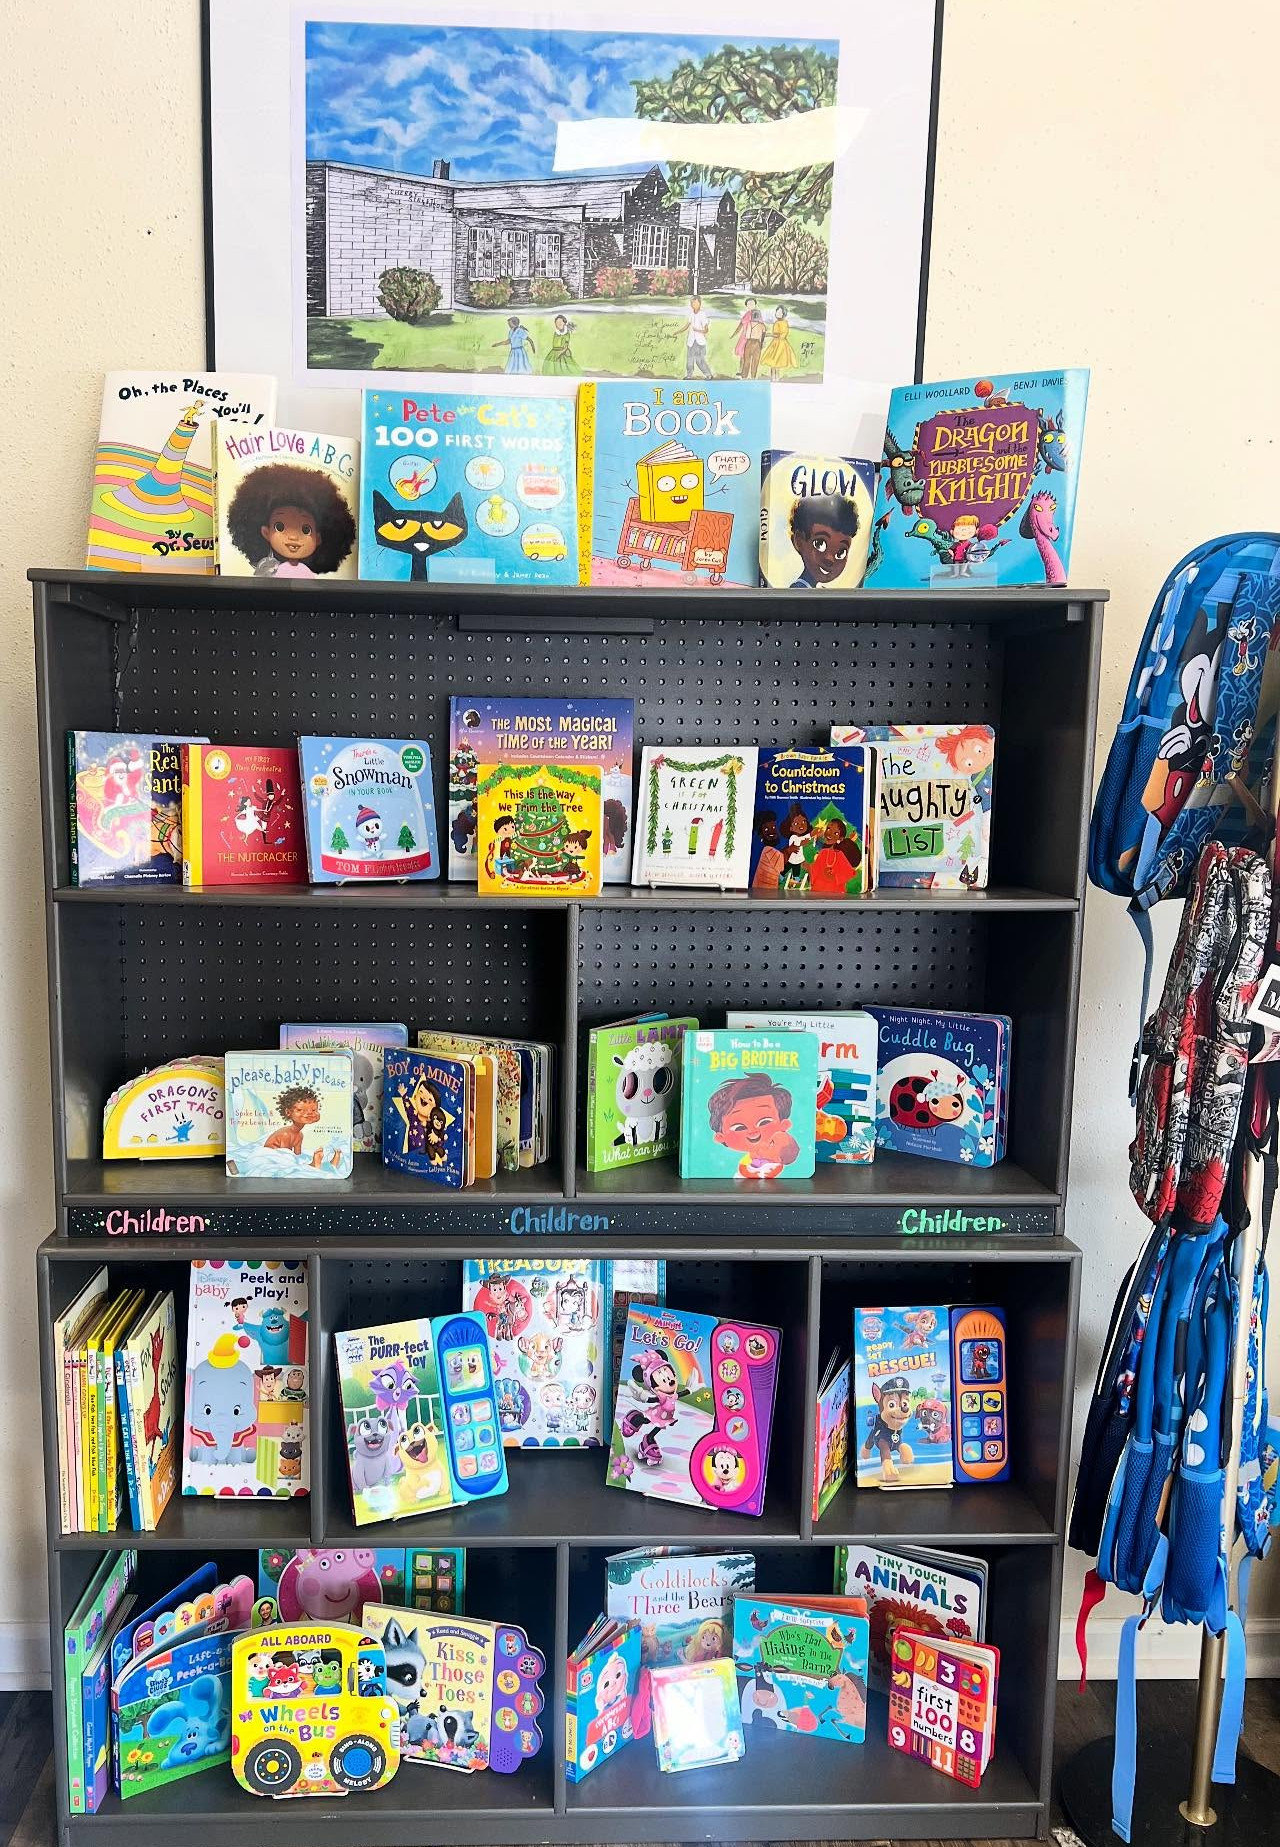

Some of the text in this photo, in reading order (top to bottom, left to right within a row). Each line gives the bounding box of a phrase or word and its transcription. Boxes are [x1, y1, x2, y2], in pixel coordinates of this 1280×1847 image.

[118, 378, 229, 401] Oh, the Places
[653, 388, 710, 406] I am
[904, 390, 921, 401] ELLI
[925, 386, 971, 399] WOOLLARD
[1012, 380, 1038, 391] BENJI
[211, 403, 251, 417] You'll
[402, 399, 457, 424] Pete
[476, 404, 537, 428] Cat's
[623, 401, 742, 437] Book
[954, 415, 975, 427] The
[225, 431, 265, 460] Hair
[269, 430, 305, 454] Love
[374, 425, 564, 452] 100 FIRST WORDS
[931, 420, 1029, 454] DRAGON
[714, 455, 746, 463] THAT'S
[996, 444, 1028, 455] and the
[790, 465, 857, 497] GLOW
[165, 529, 182, 540] By
[152, 540, 181, 557] Dr.
[161, 743, 175, 754] The
[251, 764, 282, 773] Orchestra
[364, 757, 385, 766] Little
[771, 763, 840, 778] Countdown
[332, 766, 413, 790] Snowman
[670, 777, 719, 790] GREEN
[765, 780, 846, 794] to Christmas
[377, 787, 393, 795] BOOK
[504, 790, 575, 802] This Is the Way
[498, 803, 583, 812] We Trim the Tree
[664, 801, 723, 813] CHRISTMAS
[217, 851, 298, 862] THE NUTCRACKER
[335, 861, 361, 873] TOM
[889, 1015, 971, 1032] Night Night, My Little
[731, 1038, 751, 1049] How
[753, 1038, 762, 1048] to
[879, 1025, 975, 1066] Cuddle Bug
[741, 1050, 800, 1069] BROTHER
[230, 1060, 347, 1094] please, baby please
[386, 1061, 461, 1094] BOY of MINE
[148, 1085, 218, 1102] DRAGON'S
[140, 1100, 224, 1123] FIRST TACO
[602, 1146, 631, 1163] What
[633, 1147, 651, 1156] can
[652, 1142, 671, 1157] you
[105, 1209, 205, 1236] Children
[510, 1206, 609, 1235] Children
[900, 1208, 1001, 1233] Children
[240, 1272, 305, 1284] Peek and
[195, 1284, 230, 1299] baby
[254, 1286, 289, 1301] Play!
[368, 1336, 386, 1347] The
[631, 1325, 703, 1353] Let's Go!
[369, 1340, 429, 1361] PURR-fect
[406, 1355, 427, 1369] Toy
[868, 1352, 937, 1377] RESCUE!
[120, 1413, 128, 1425] THE
[640, 1568, 728, 1590] Goldilocks
[907, 1564, 947, 1586] TOUCH
[627, 1590, 734, 1615] Three Bears
[653, 1591, 685, 1602] and the
[260, 1634, 332, 1647] ALL ABOARD
[778, 1629, 822, 1647] Who's That
[437, 1641, 475, 1665] Kiss
[764, 1640, 806, 1658] Hiding
[819, 1650, 832, 1661] The
[429, 1661, 485, 1685] Those
[802, 1658, 832, 1676] Barn?
[940, 1660, 956, 1684] 3
[436, 1682, 476, 1704] Toes
[916, 1686, 953, 1713] first
[260, 1703, 340, 1724] Wheels
[914, 1700, 953, 1733] 100
[263, 1724, 337, 1742] on the Bus
[891, 1725, 906, 1747] 9
[912, 1719, 953, 1745] numbers
[959, 1729, 976, 1754] 8
[933, 1745, 954, 1774] 11
[343, 1776, 371, 1788] MELODY
